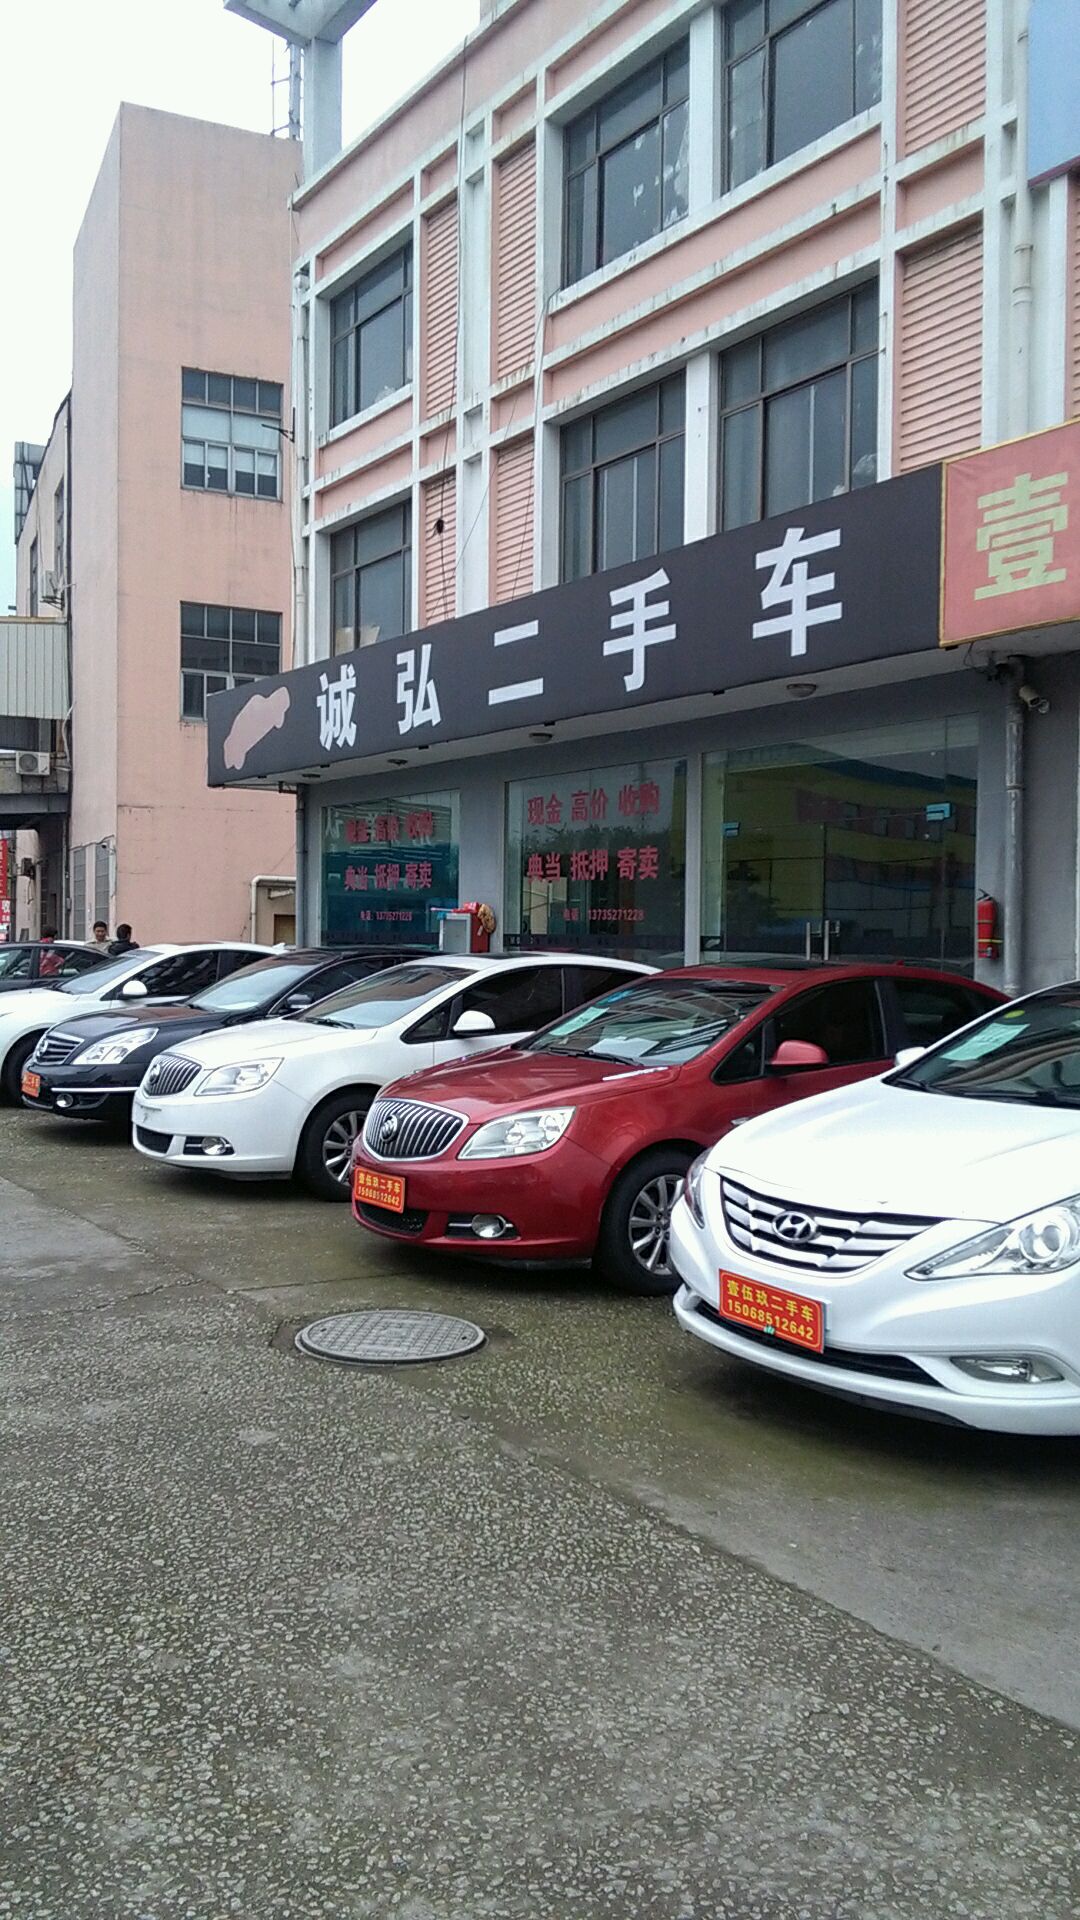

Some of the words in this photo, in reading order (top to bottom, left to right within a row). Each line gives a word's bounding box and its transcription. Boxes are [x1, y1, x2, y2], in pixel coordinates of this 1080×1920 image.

[974, 472, 1069, 601] 壹
[316, 526, 843, 752] 诚弘二手车
[527, 794, 562, 826] 现金
[571, 788, 608, 822] 高价
[618, 781, 661, 816] 收购
[344, 865, 368, 891] 典当
[374, 863, 400, 891] 抵押
[405, 861, 432, 890] 寄卖
[527, 852, 562, 883] 典当
[570, 848, 609, 881] 抵押
[617, 846, 659, 881] 寄卖
[727, 1279, 814, 1323] 壹伍玖二手车
[727, 1299, 814, 1341] 15068512642
